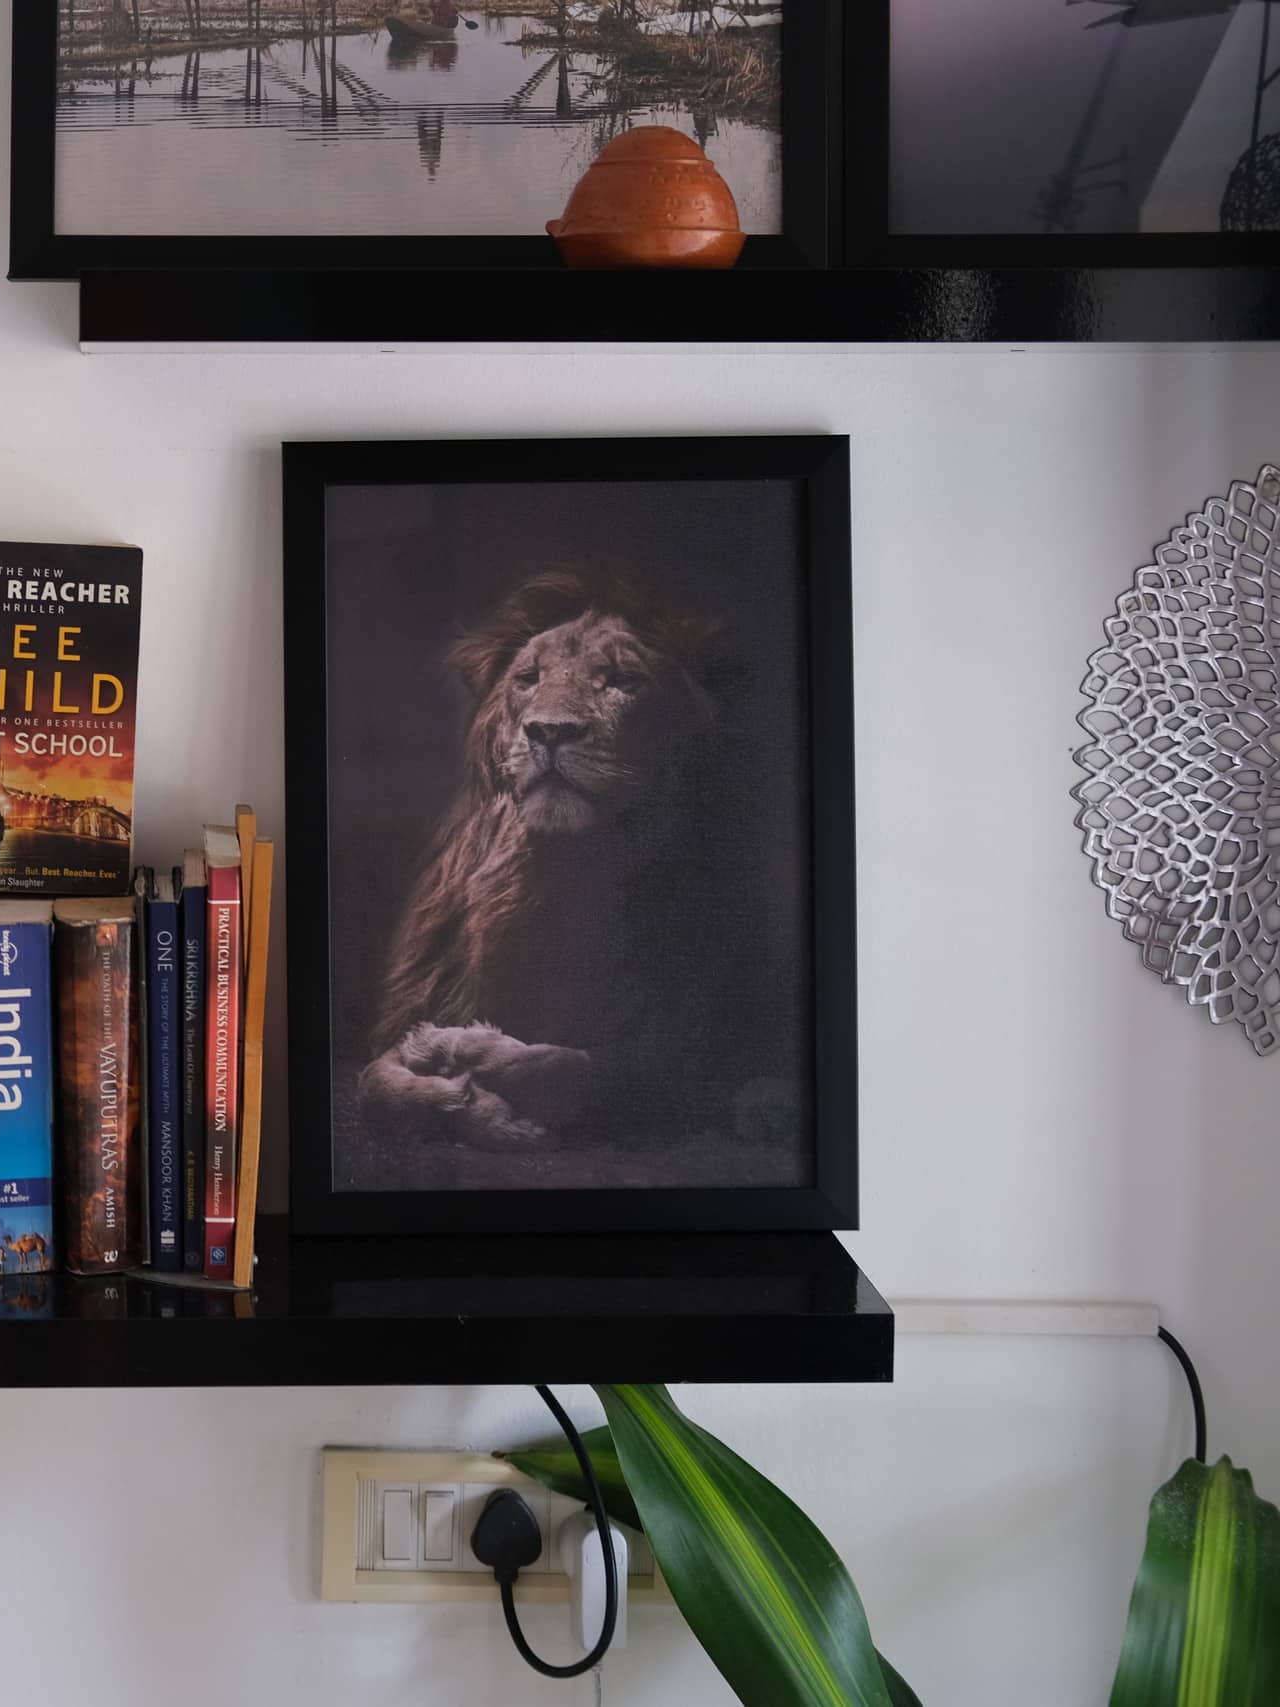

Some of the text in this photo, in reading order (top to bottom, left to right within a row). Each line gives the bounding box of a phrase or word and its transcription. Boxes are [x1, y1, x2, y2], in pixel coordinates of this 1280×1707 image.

[33, 567, 64, 579] NEW
[7, 579, 131, 605] REACHER
[14, 717, 40, 727] ONE
[46, 719, 124, 730] BESTSELLER
[14, 732, 123, 757] SCHOOL
[7, 877, 45, 888] Slaughter
[157, 930, 173, 972] ONE
[186, 939, 199, 959] SRI
[185, 961, 199, 1021] KRISHNA
[215, 907, 230, 1132] PRACTICAL BUSINESS COMMUNICATION
[99, 952, 119, 1170] THE OATH OF THE VAYUPUTRAS
[212, 1145, 223, 1170] Henry
[160, 1120, 173, 1221] MANSOOR KHAN
[3, 1182, 18, 1195] #1
[105, 1186, 116, 1229] AMISH
